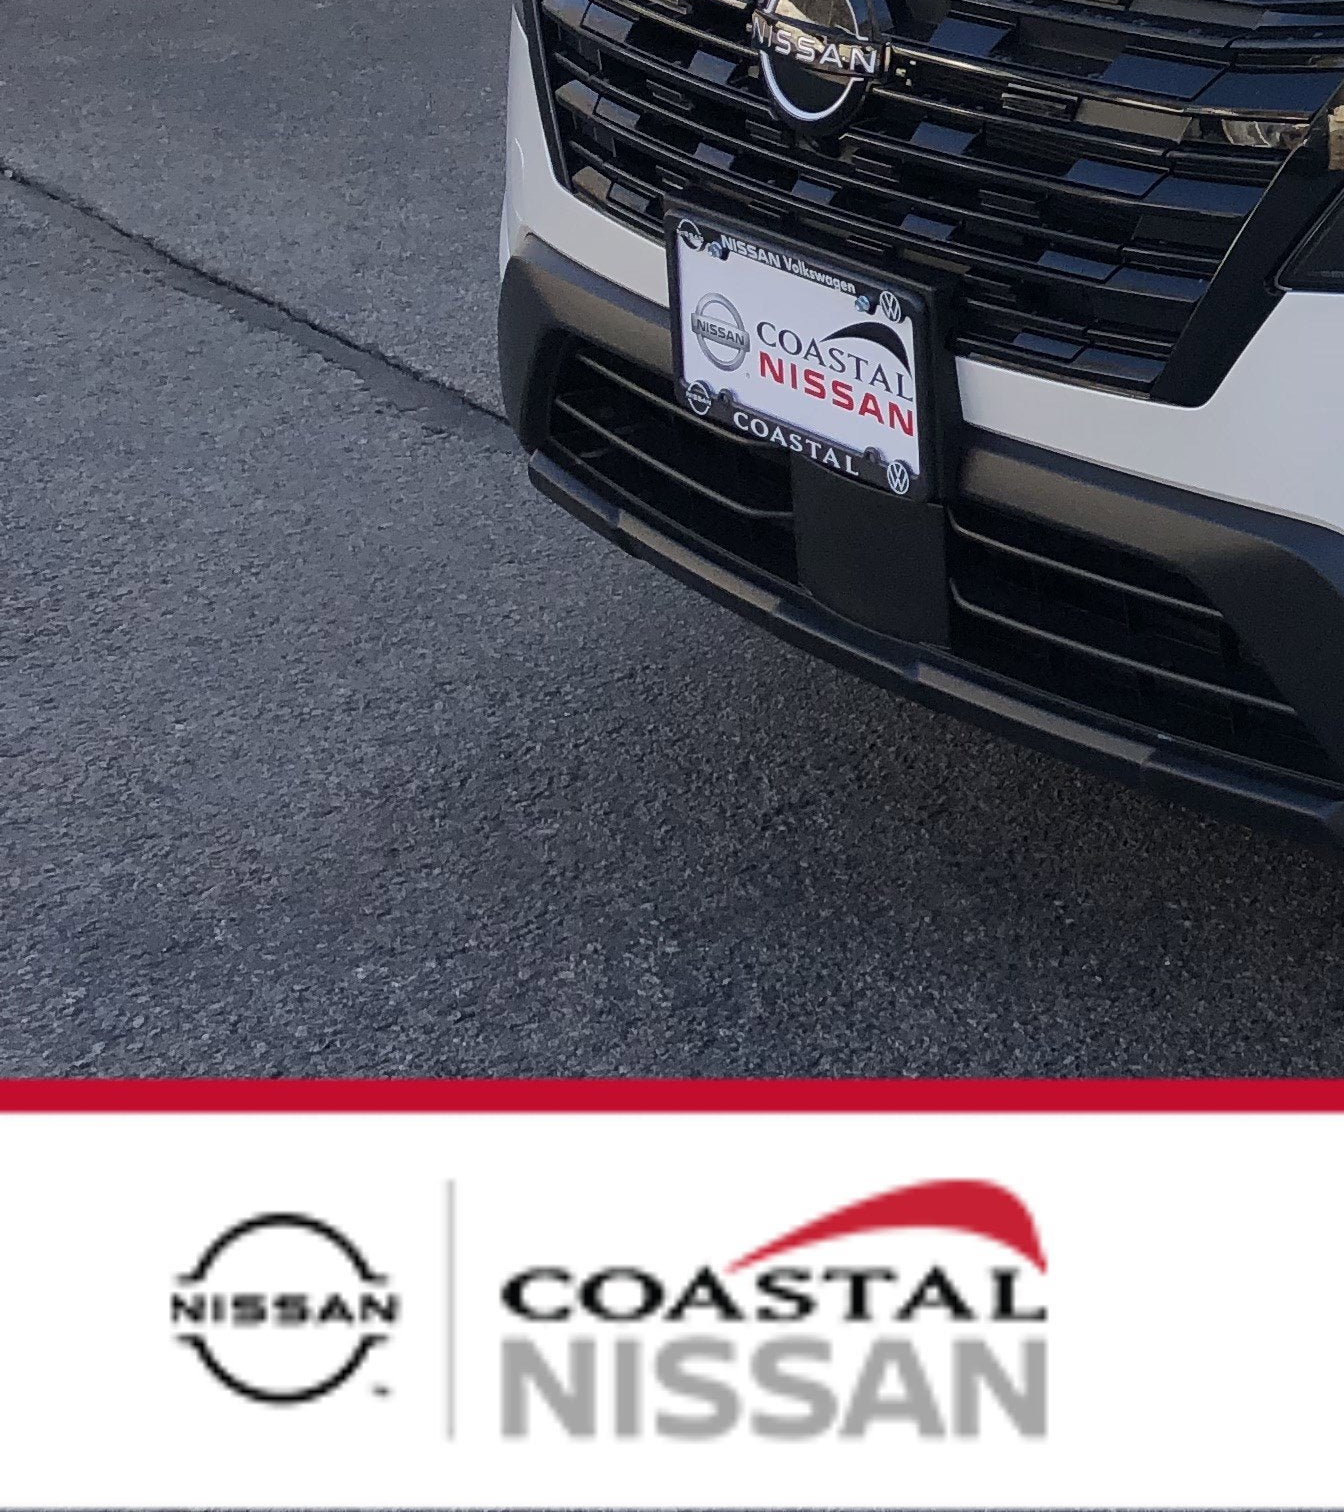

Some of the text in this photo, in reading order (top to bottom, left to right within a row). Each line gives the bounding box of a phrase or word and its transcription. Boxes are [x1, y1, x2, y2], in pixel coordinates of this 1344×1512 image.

[752, 16, 877, 74] NISSAN
[721, 234, 780, 270] NISSAN
[782, 255, 856, 295] Volkswagen
[696, 317, 745, 345] NISSAN
[756, 321, 914, 402] COASTAL
[759, 350, 914, 437] NISSAN
[733, 411, 859, 477] COASTAL
